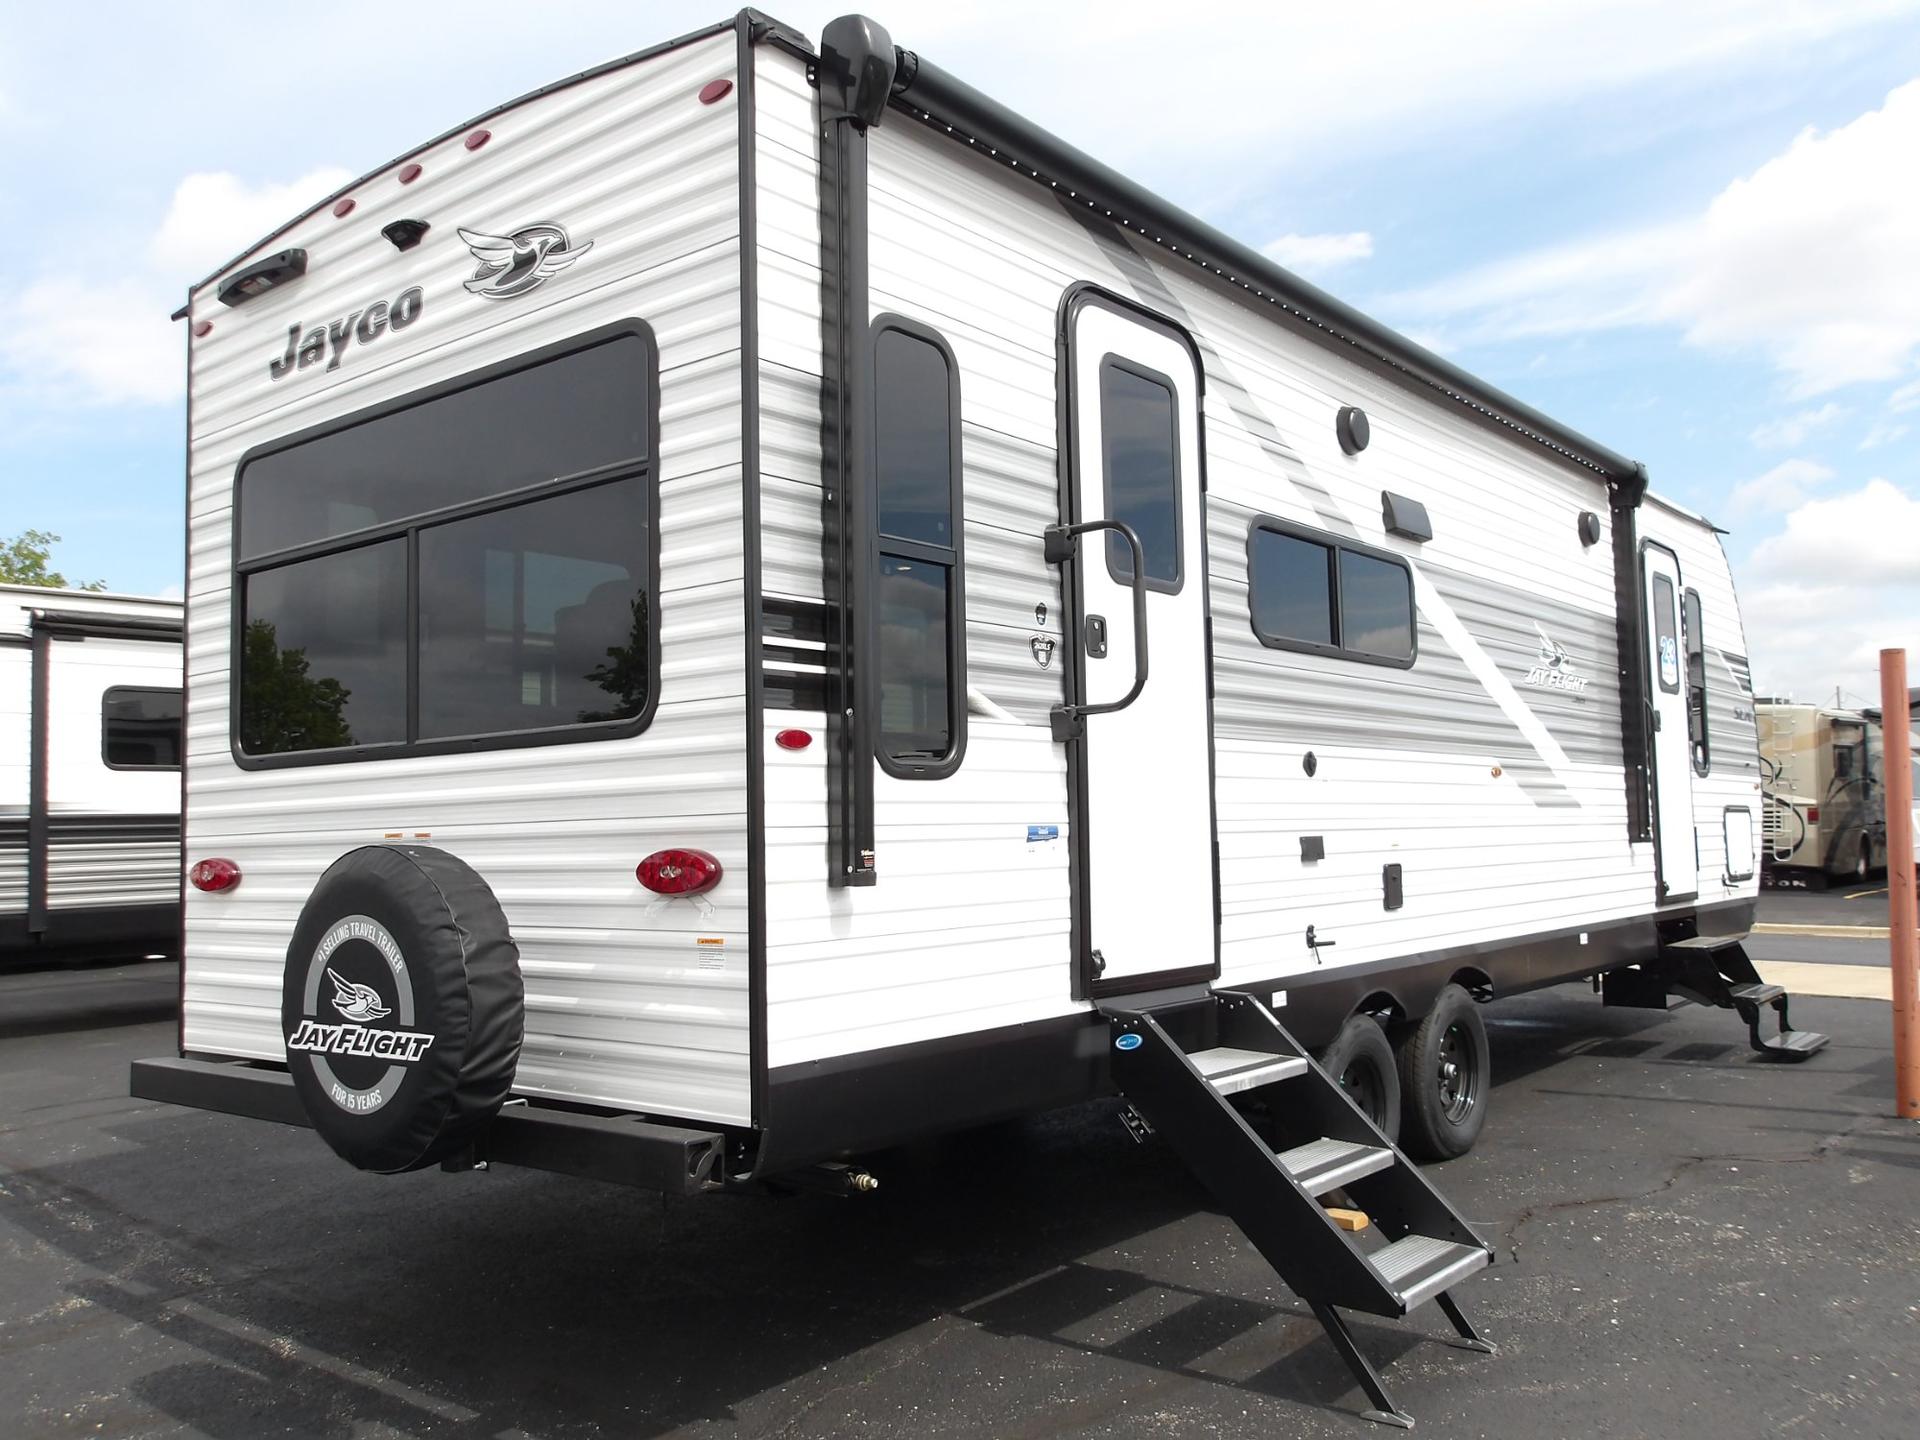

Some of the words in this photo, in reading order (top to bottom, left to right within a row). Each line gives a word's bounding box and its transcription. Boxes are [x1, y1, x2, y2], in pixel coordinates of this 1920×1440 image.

[269, 285, 425, 382] Jayco
[322, 924, 350, 955] SELLING
[350, 921, 377, 941] TRAVEL
[377, 930, 404, 974] TRAILER
[331, 1082, 347, 1105] FOR
[347, 1093, 355, 1109] 15
[356, 1089, 382, 1110] YEARS
